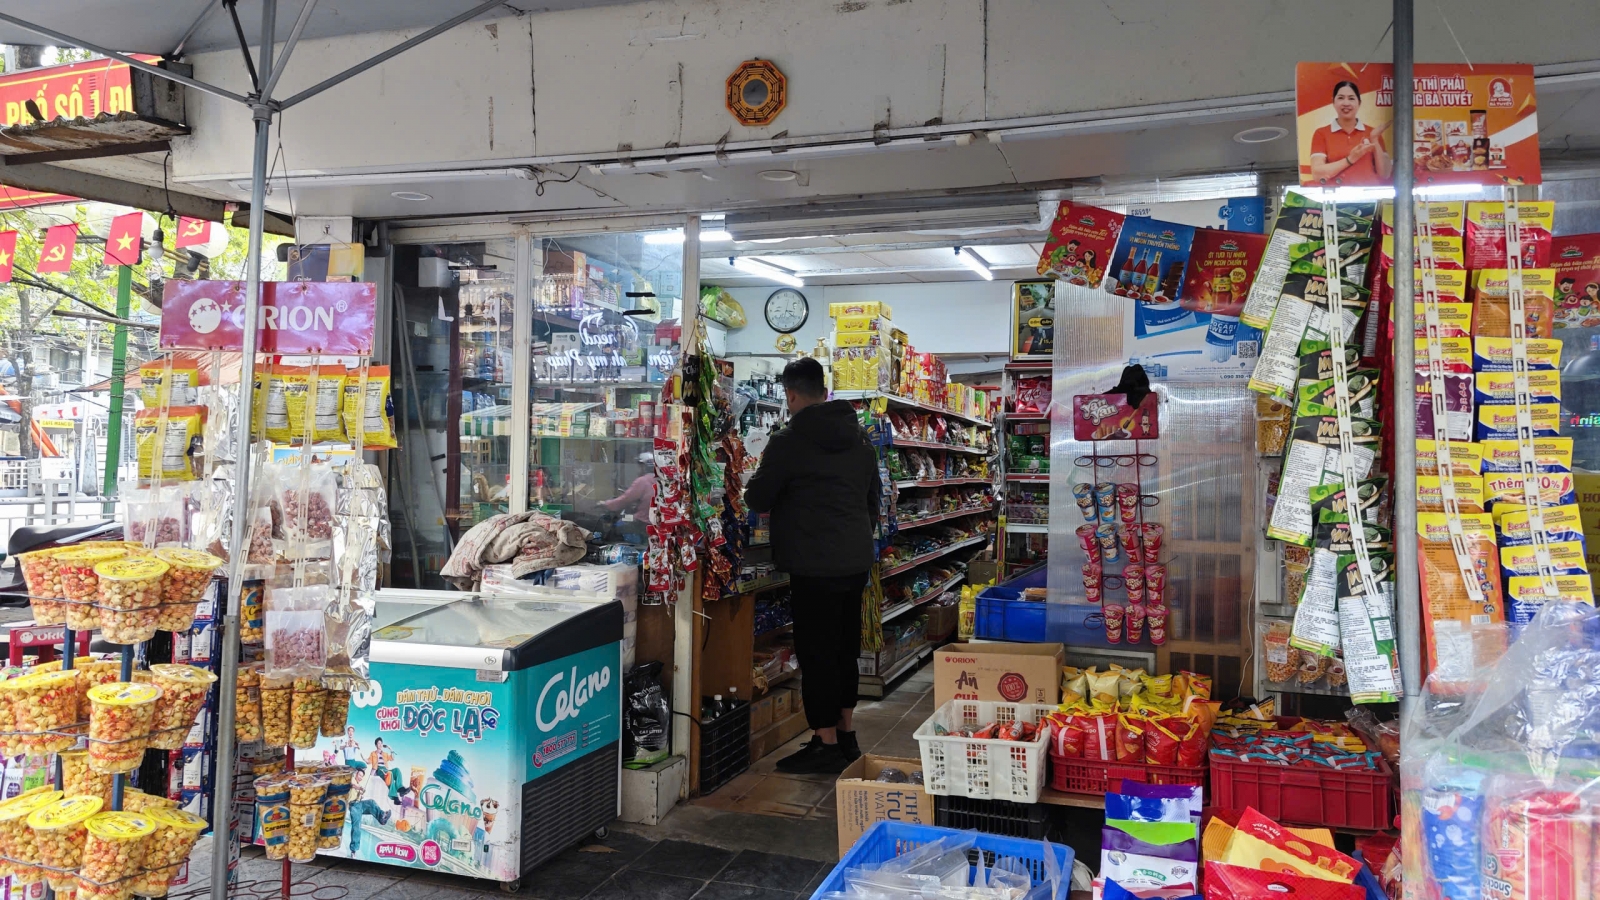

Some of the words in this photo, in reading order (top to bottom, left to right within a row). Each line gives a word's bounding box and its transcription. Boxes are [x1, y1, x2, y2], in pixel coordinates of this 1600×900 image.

[1421, 76, 1438, 91] THÌ
[1440, 74, 1465, 90] PHẢI
[90, 89, 100, 119] 1
[1424, 91, 1440, 106] BÀ
[1441, 89, 1473, 106] TUYẾT
[1485, 278, 1509, 287] Bent
[1488, 346, 1513, 356] Bent
[1489, 381, 1515, 390] Bent
[1020, 388, 1041, 401] KitKat
[1493, 414, 1518, 423] Bent
[1493, 449, 1520, 458] Bent
[1489, 477, 1524, 491] Thêm
[1537, 475, 1560, 489] 0%
[1419, 486, 1442, 494] Bent
[1425, 523, 1451, 533] Bent
[1507, 521, 1531, 531] Bent
[1511, 556, 1537, 565] Bent
[1519, 586, 1545, 596] Bent
[535, 665, 611, 733] Celano
[402, 703, 446, 736] ĐỘC
[452, 706, 482, 743] LẠ
[419, 783, 482, 819] Celano
[874, 791, 886, 823] WATE
[886, 790, 904, 821] tru
[905, 791, 918, 816] TH
